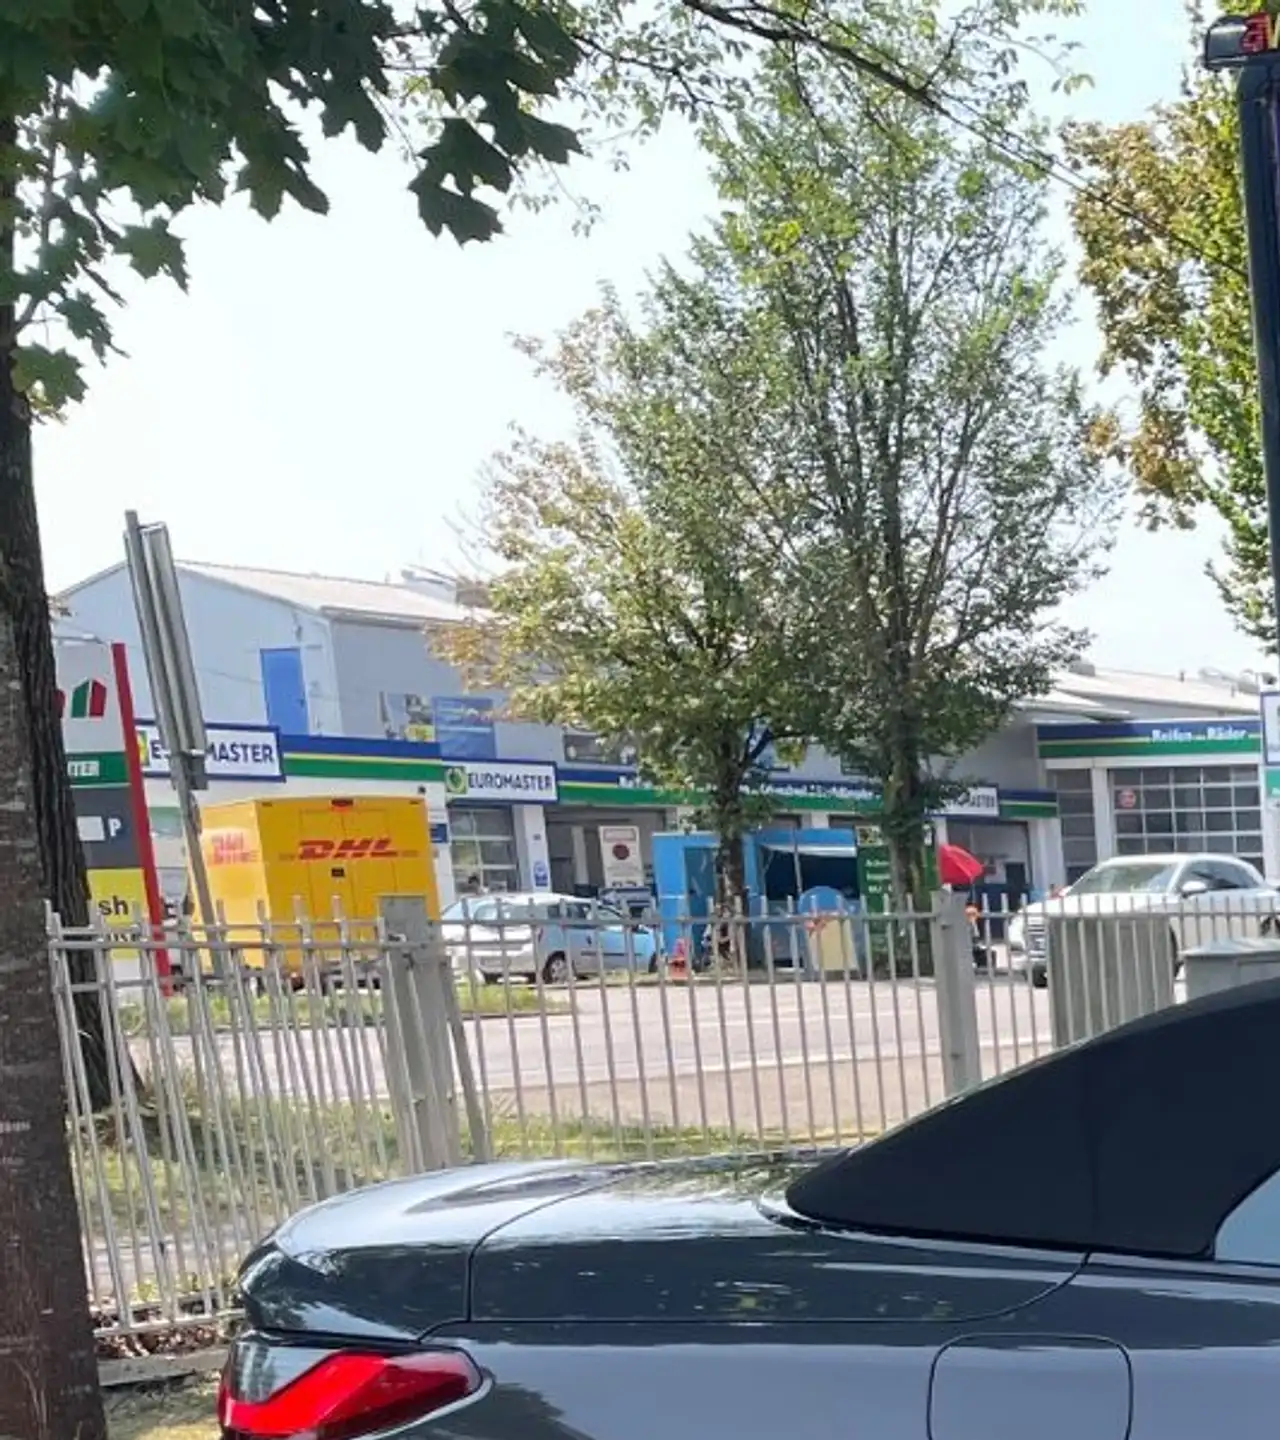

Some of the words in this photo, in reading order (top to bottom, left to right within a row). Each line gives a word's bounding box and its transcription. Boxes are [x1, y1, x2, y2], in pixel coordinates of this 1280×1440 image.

[149, 739, 274, 764] EMASTER
[467, 771, 552, 791] EUROMASTER
[298, 838, 399, 861] DHL
